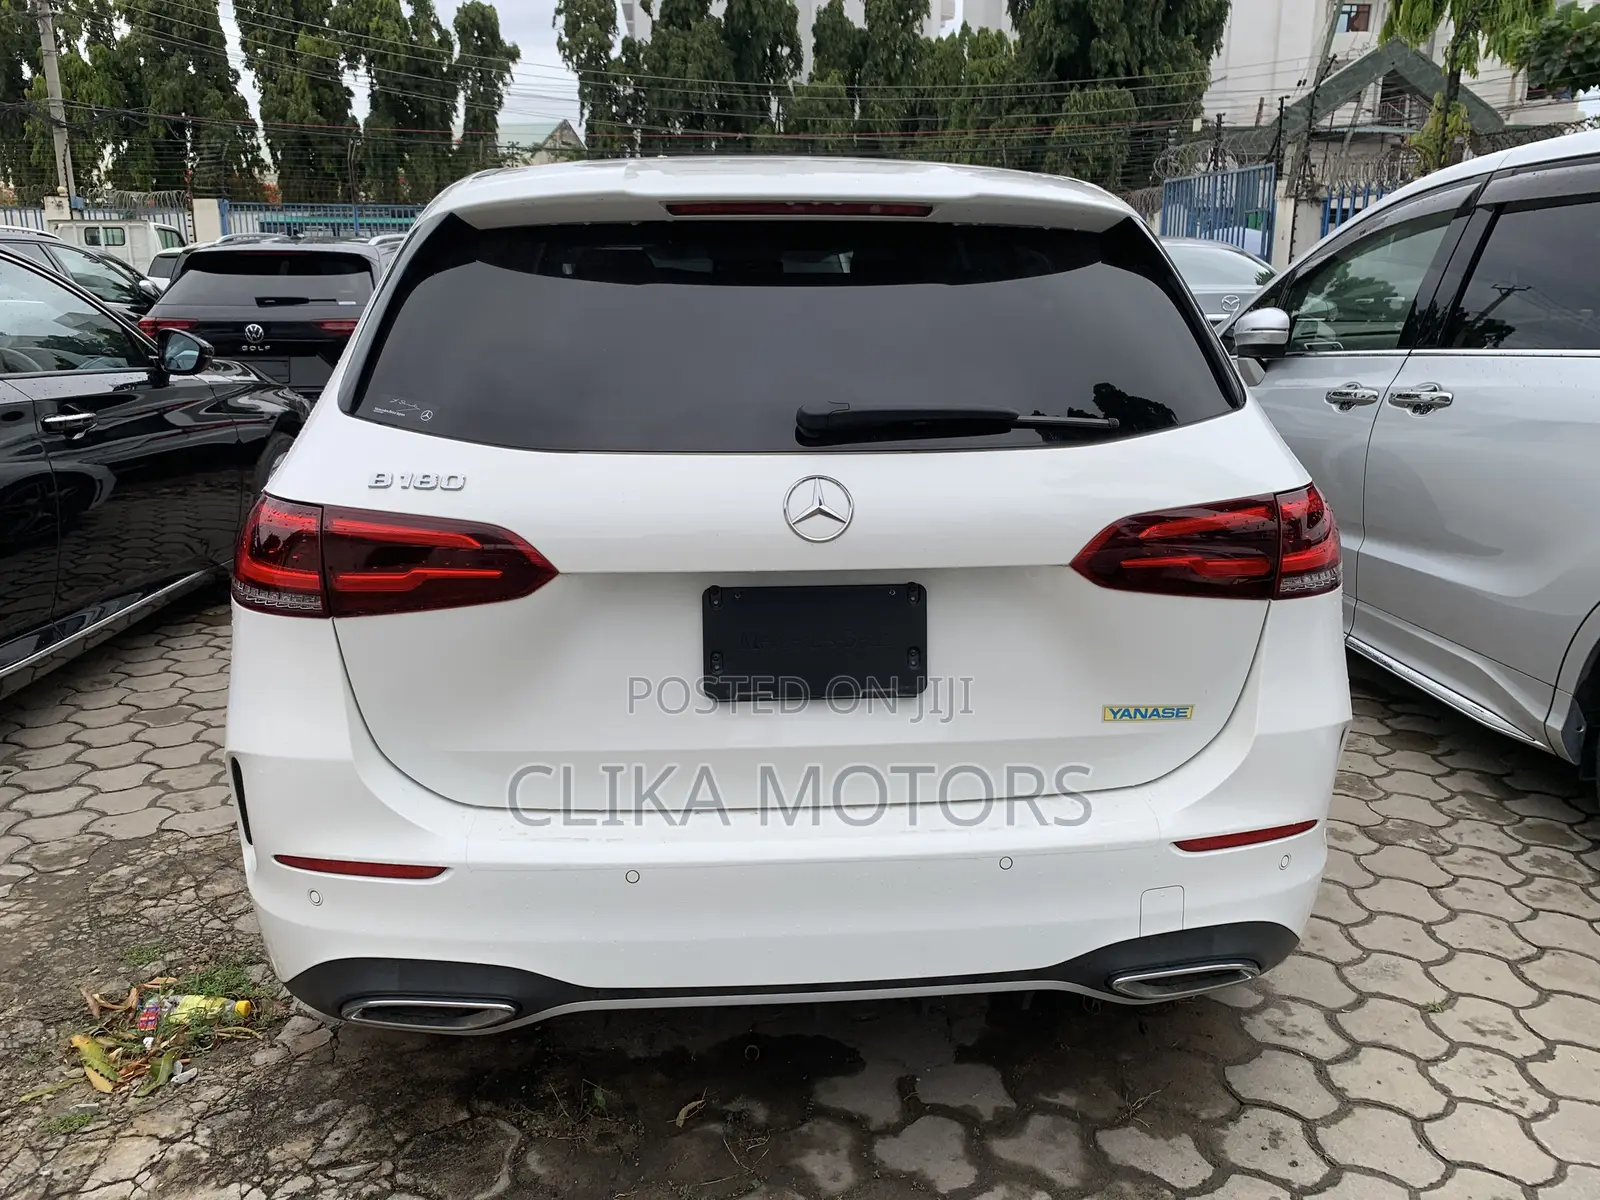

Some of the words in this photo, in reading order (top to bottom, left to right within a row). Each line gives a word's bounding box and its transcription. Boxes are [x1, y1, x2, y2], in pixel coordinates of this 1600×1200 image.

[368, 472, 394, 489] B
[400, 472, 466, 491] 180
[1108, 707, 1189, 719] YANASE
